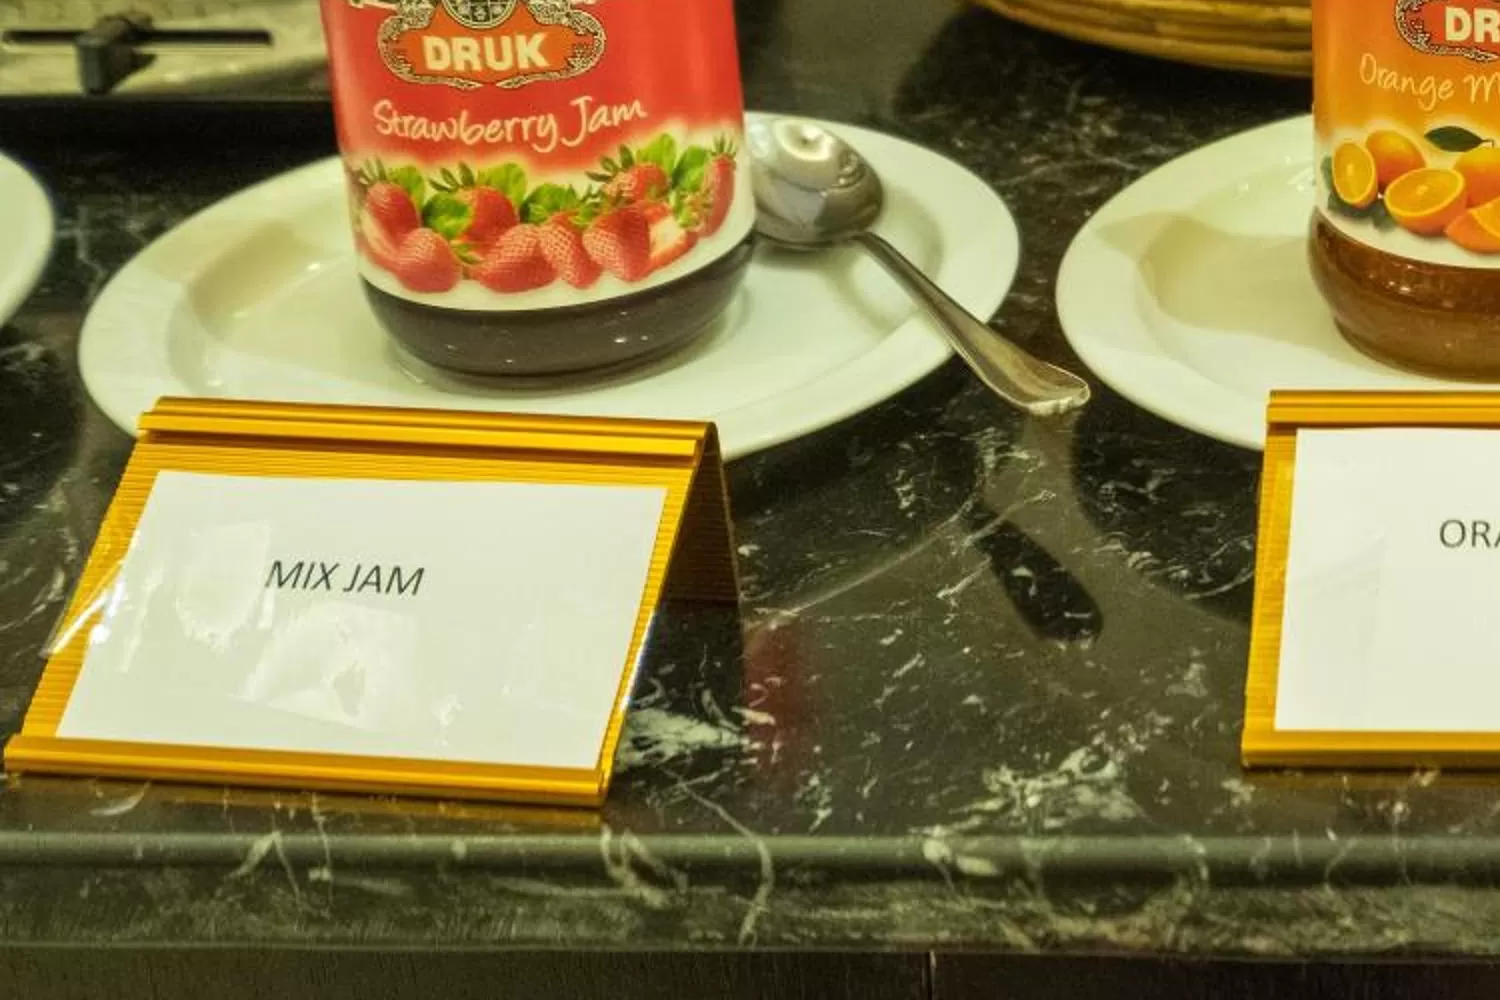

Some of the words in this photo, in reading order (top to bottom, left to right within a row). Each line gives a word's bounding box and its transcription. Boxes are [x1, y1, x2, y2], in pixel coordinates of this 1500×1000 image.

[422, 32, 550, 73] DRUK
[1359, 52, 1455, 111] Orange
[373, 99, 559, 153] Strawberry
[560, 94, 649, 148] Jam
[264, 559, 340, 591] MIX
[342, 563, 426, 597] JAM
